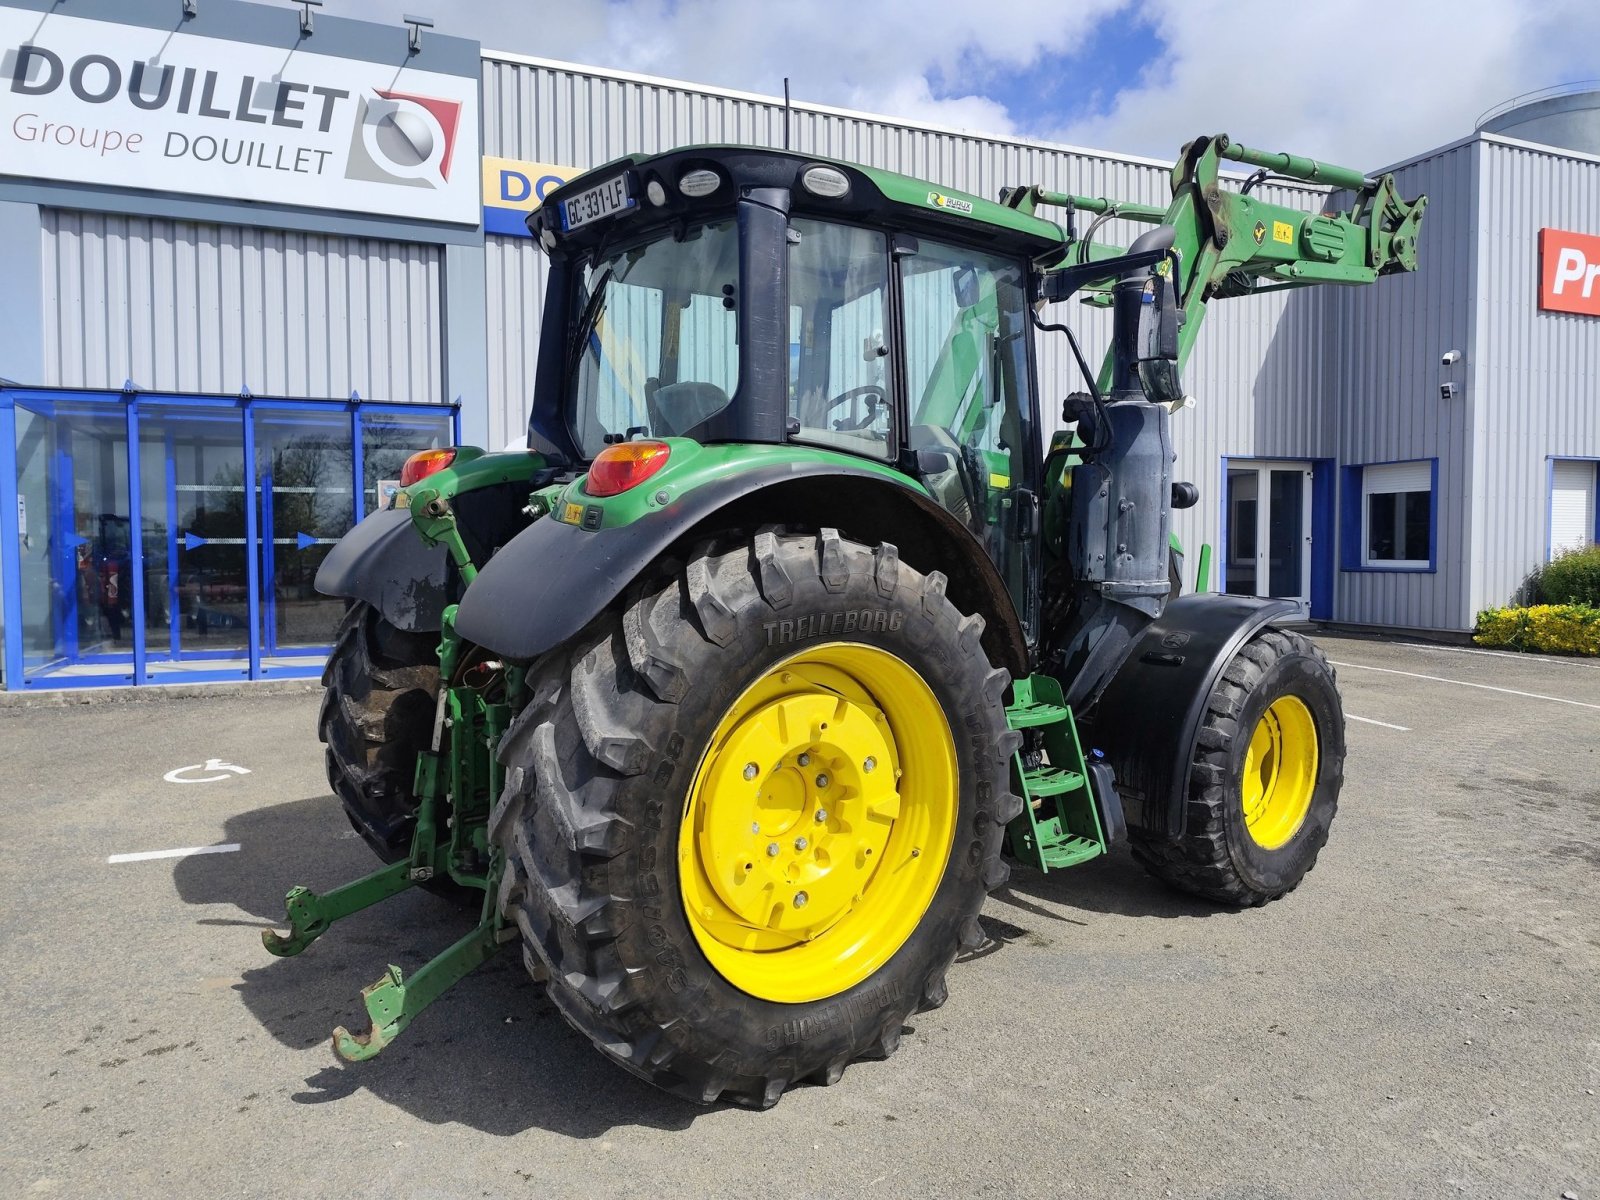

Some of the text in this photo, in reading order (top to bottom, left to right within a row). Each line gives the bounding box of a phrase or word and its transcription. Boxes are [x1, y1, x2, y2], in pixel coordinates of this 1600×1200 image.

[10, 44, 350, 133] DOUILLET
[12, 113, 333, 175] Groupe DOUILLET
[762, 608, 903, 647] TRELLEBORG
